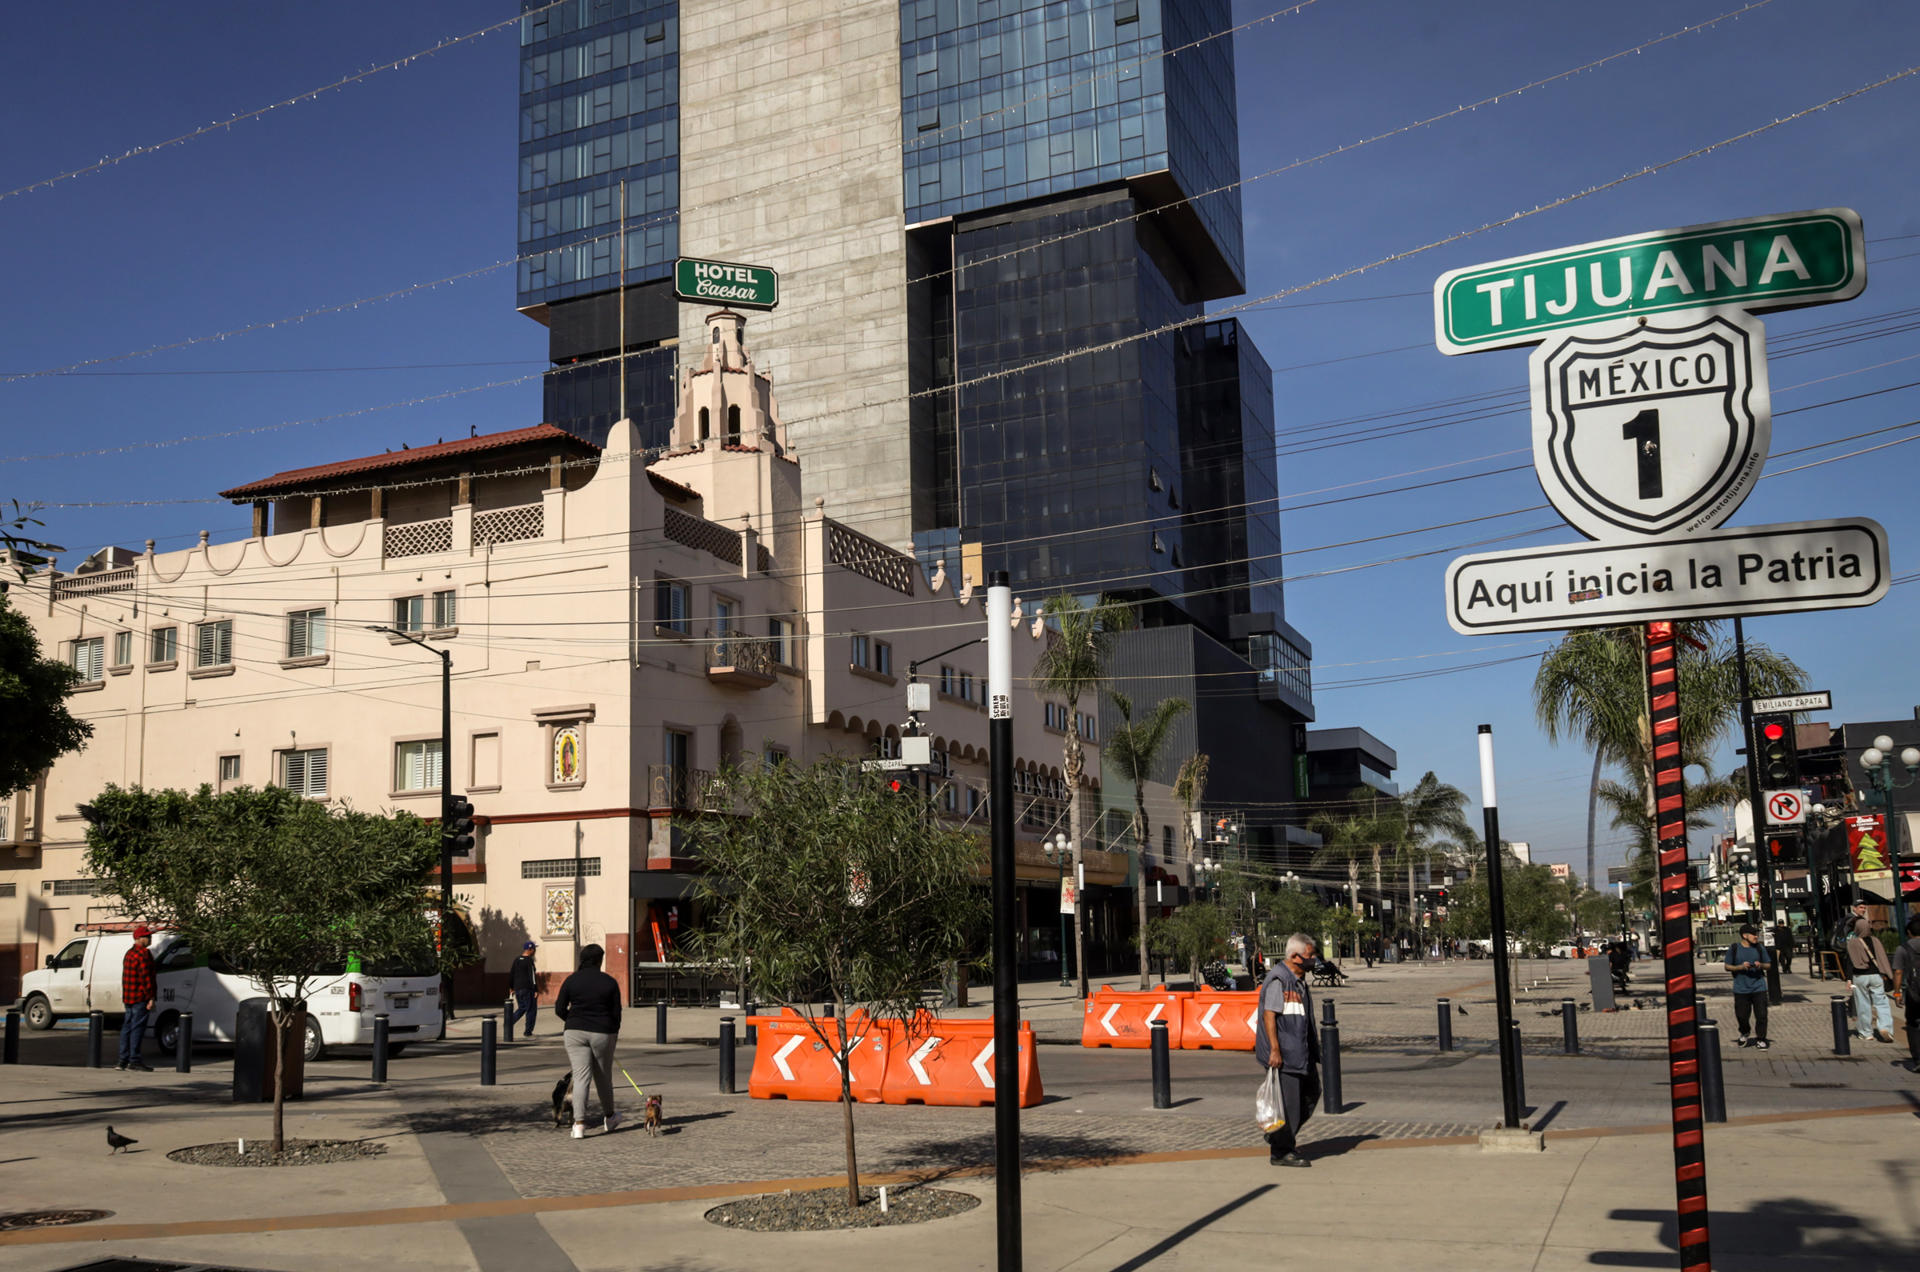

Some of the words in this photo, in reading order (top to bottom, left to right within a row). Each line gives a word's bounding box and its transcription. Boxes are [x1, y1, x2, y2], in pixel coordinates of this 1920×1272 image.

[694, 263, 758, 284] HOTEL
[696, 277, 757, 300] Caesar
[1476, 235, 1811, 326] TIJUANA
[1578, 353, 1716, 399] MÉXICO
[1622, 408, 1663, 500] 1
[1686, 452, 1760, 533] welcometotijuana.info
[1467, 571, 1553, 613] Aquí
[1568, 563, 1674, 598] inicia
[1689, 558, 1722, 590] la
[1737, 547, 1862, 585] Patria
[1757, 699, 1793, 710] EMILIANO
[1795, 697, 1823, 707] ZAPATA
